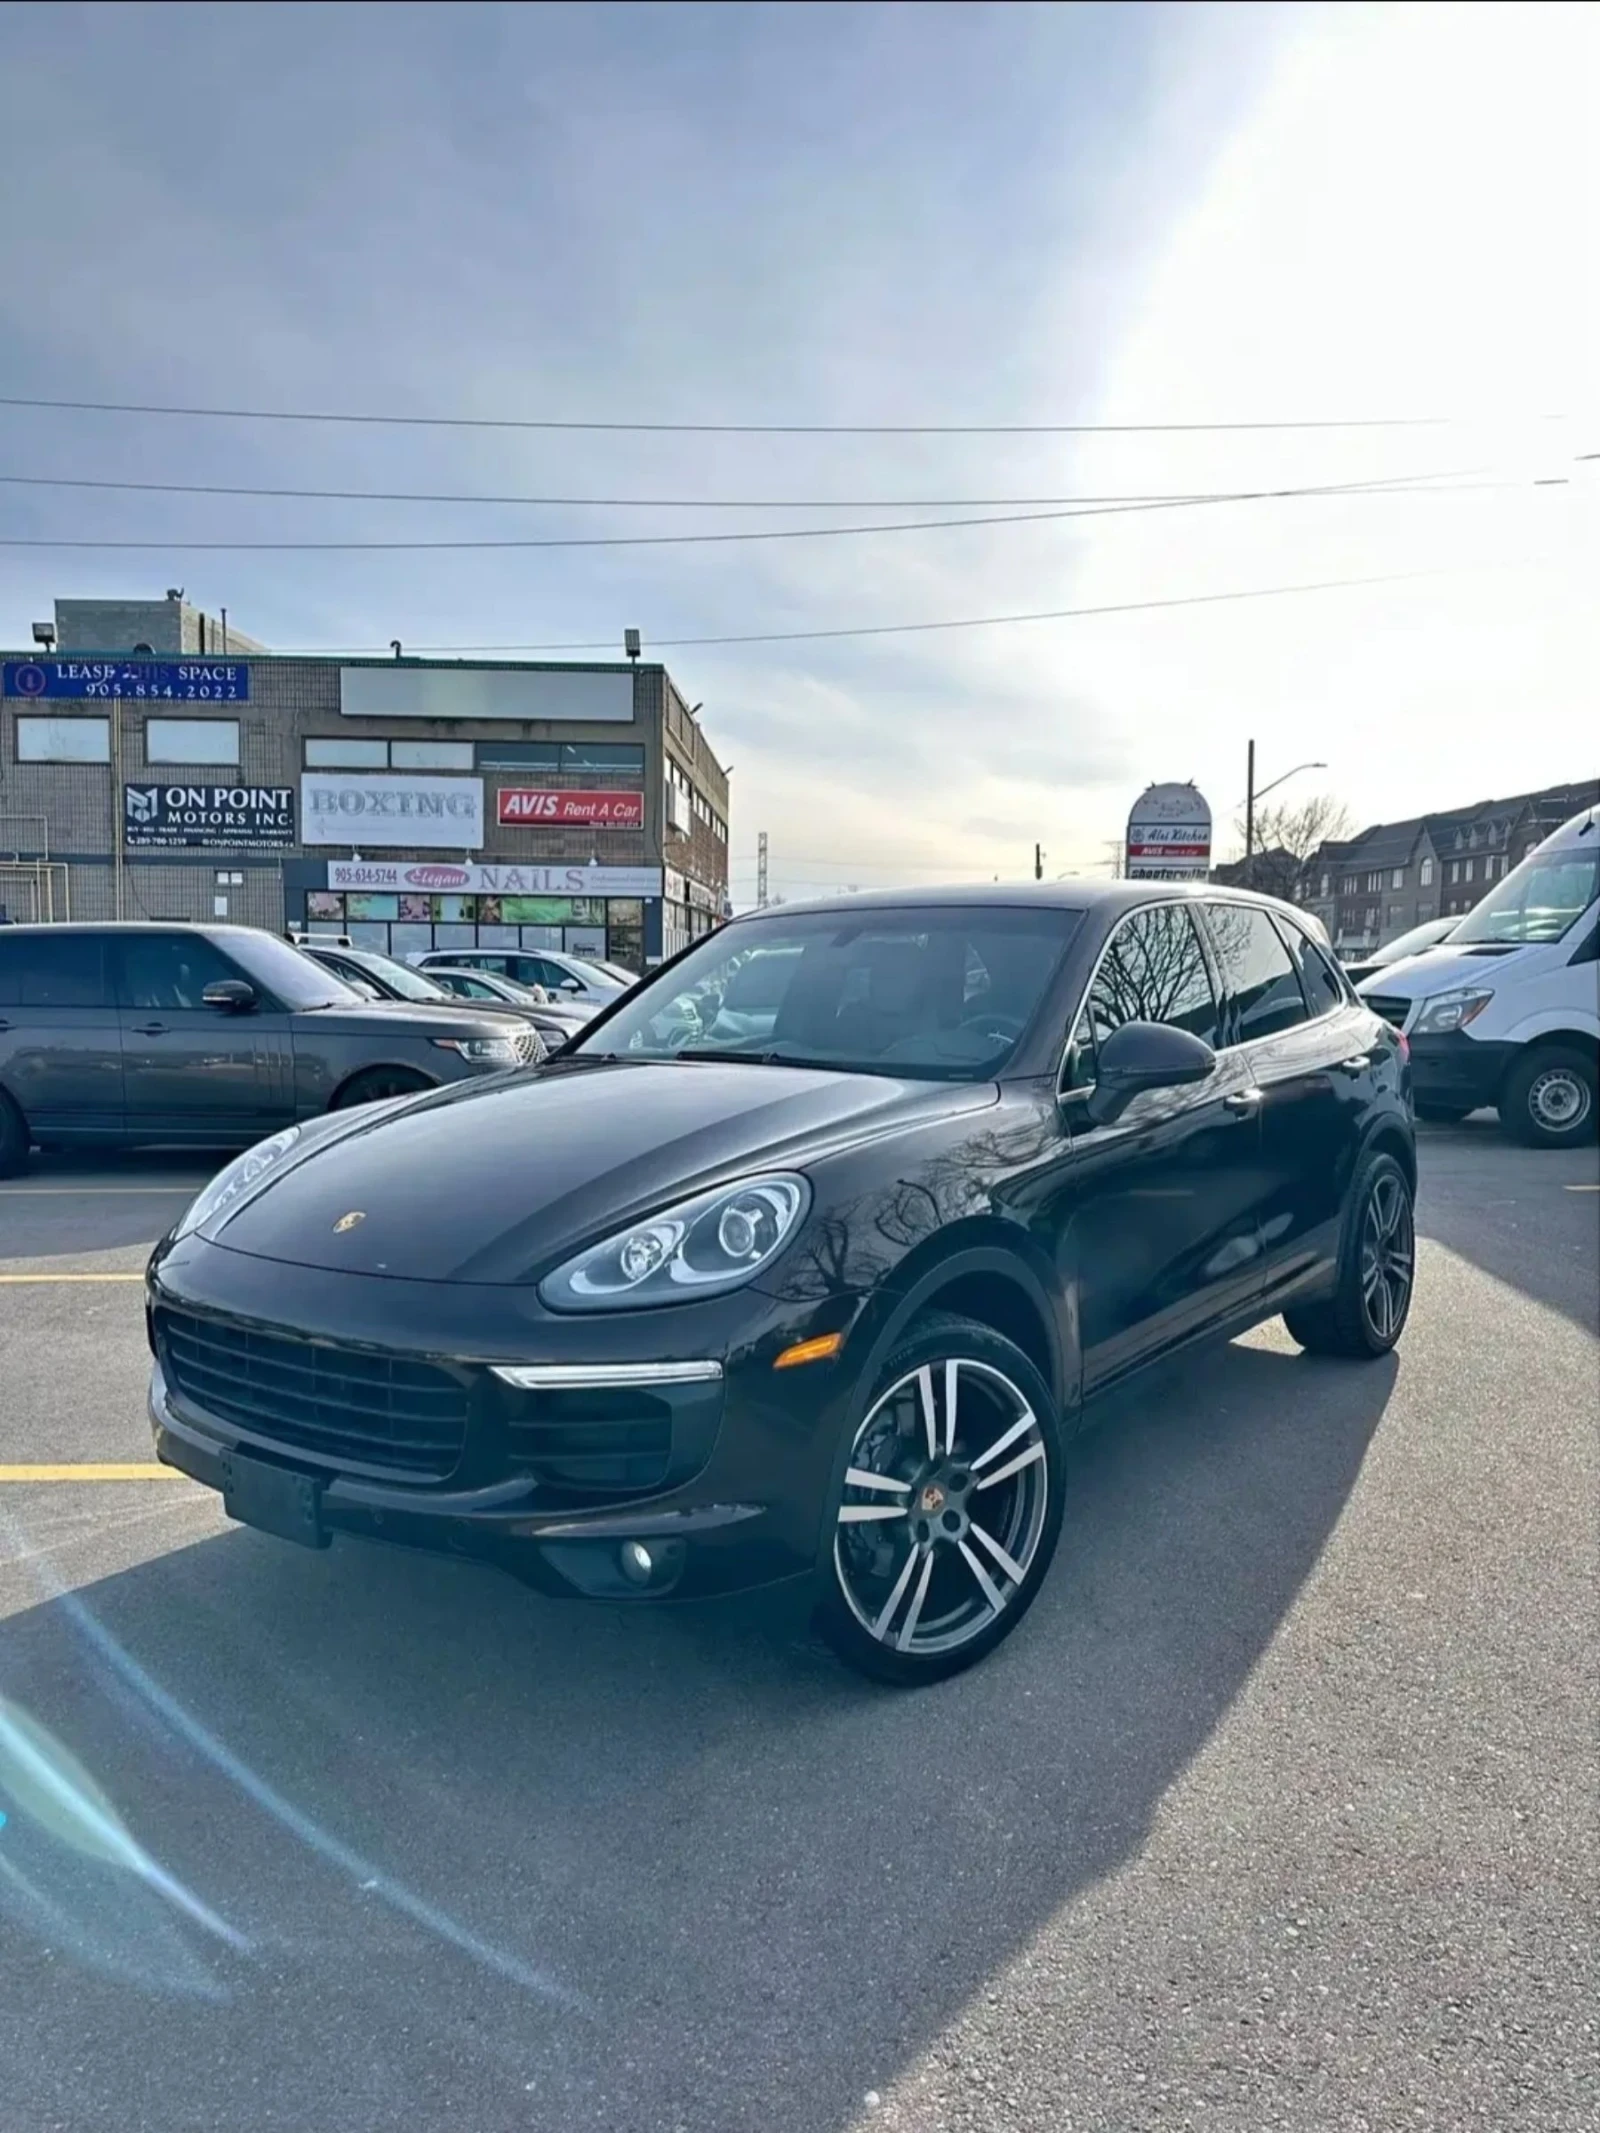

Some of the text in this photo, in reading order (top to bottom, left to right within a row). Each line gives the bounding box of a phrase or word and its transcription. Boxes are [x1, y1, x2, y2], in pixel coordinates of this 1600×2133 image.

[57, 664, 116, 679] LEASE
[178, 666, 237, 681] SPACE
[86, 683, 237, 698] 905.854.2022
[166, 787, 292, 809] ON POINT
[309, 788, 477, 819] BOXING
[504, 795, 639, 817] AVIS Rent A Car
[167, 811, 293, 826] MOTORS INC.
[334, 867, 398, 883] 905-634-5744
[410, 869, 466, 888] Elegant
[479, 867, 585, 892] NAILS
